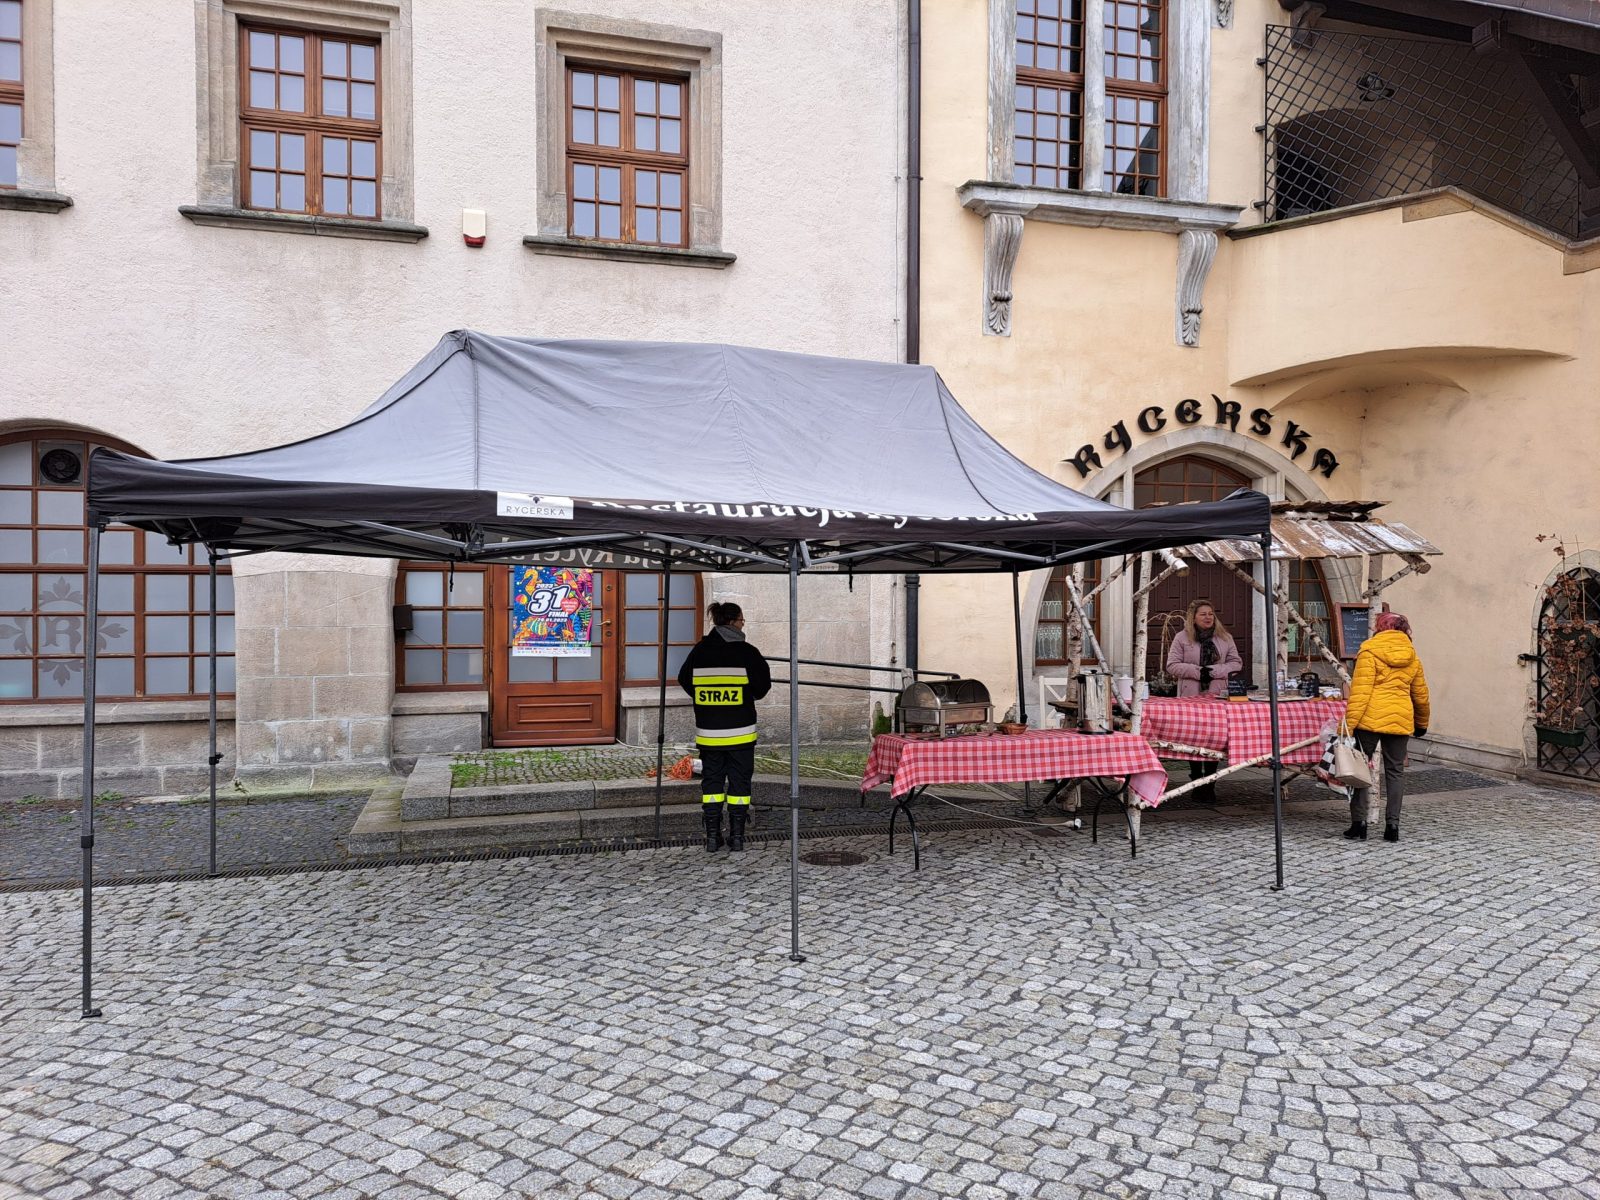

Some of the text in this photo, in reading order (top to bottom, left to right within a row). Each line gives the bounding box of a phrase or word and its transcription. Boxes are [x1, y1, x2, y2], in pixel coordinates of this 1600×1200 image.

[1062, 393, 1341, 479] RYCERSKA
[506, 505, 566, 517] RYCERSKA
[529, 586, 570, 615] 31
